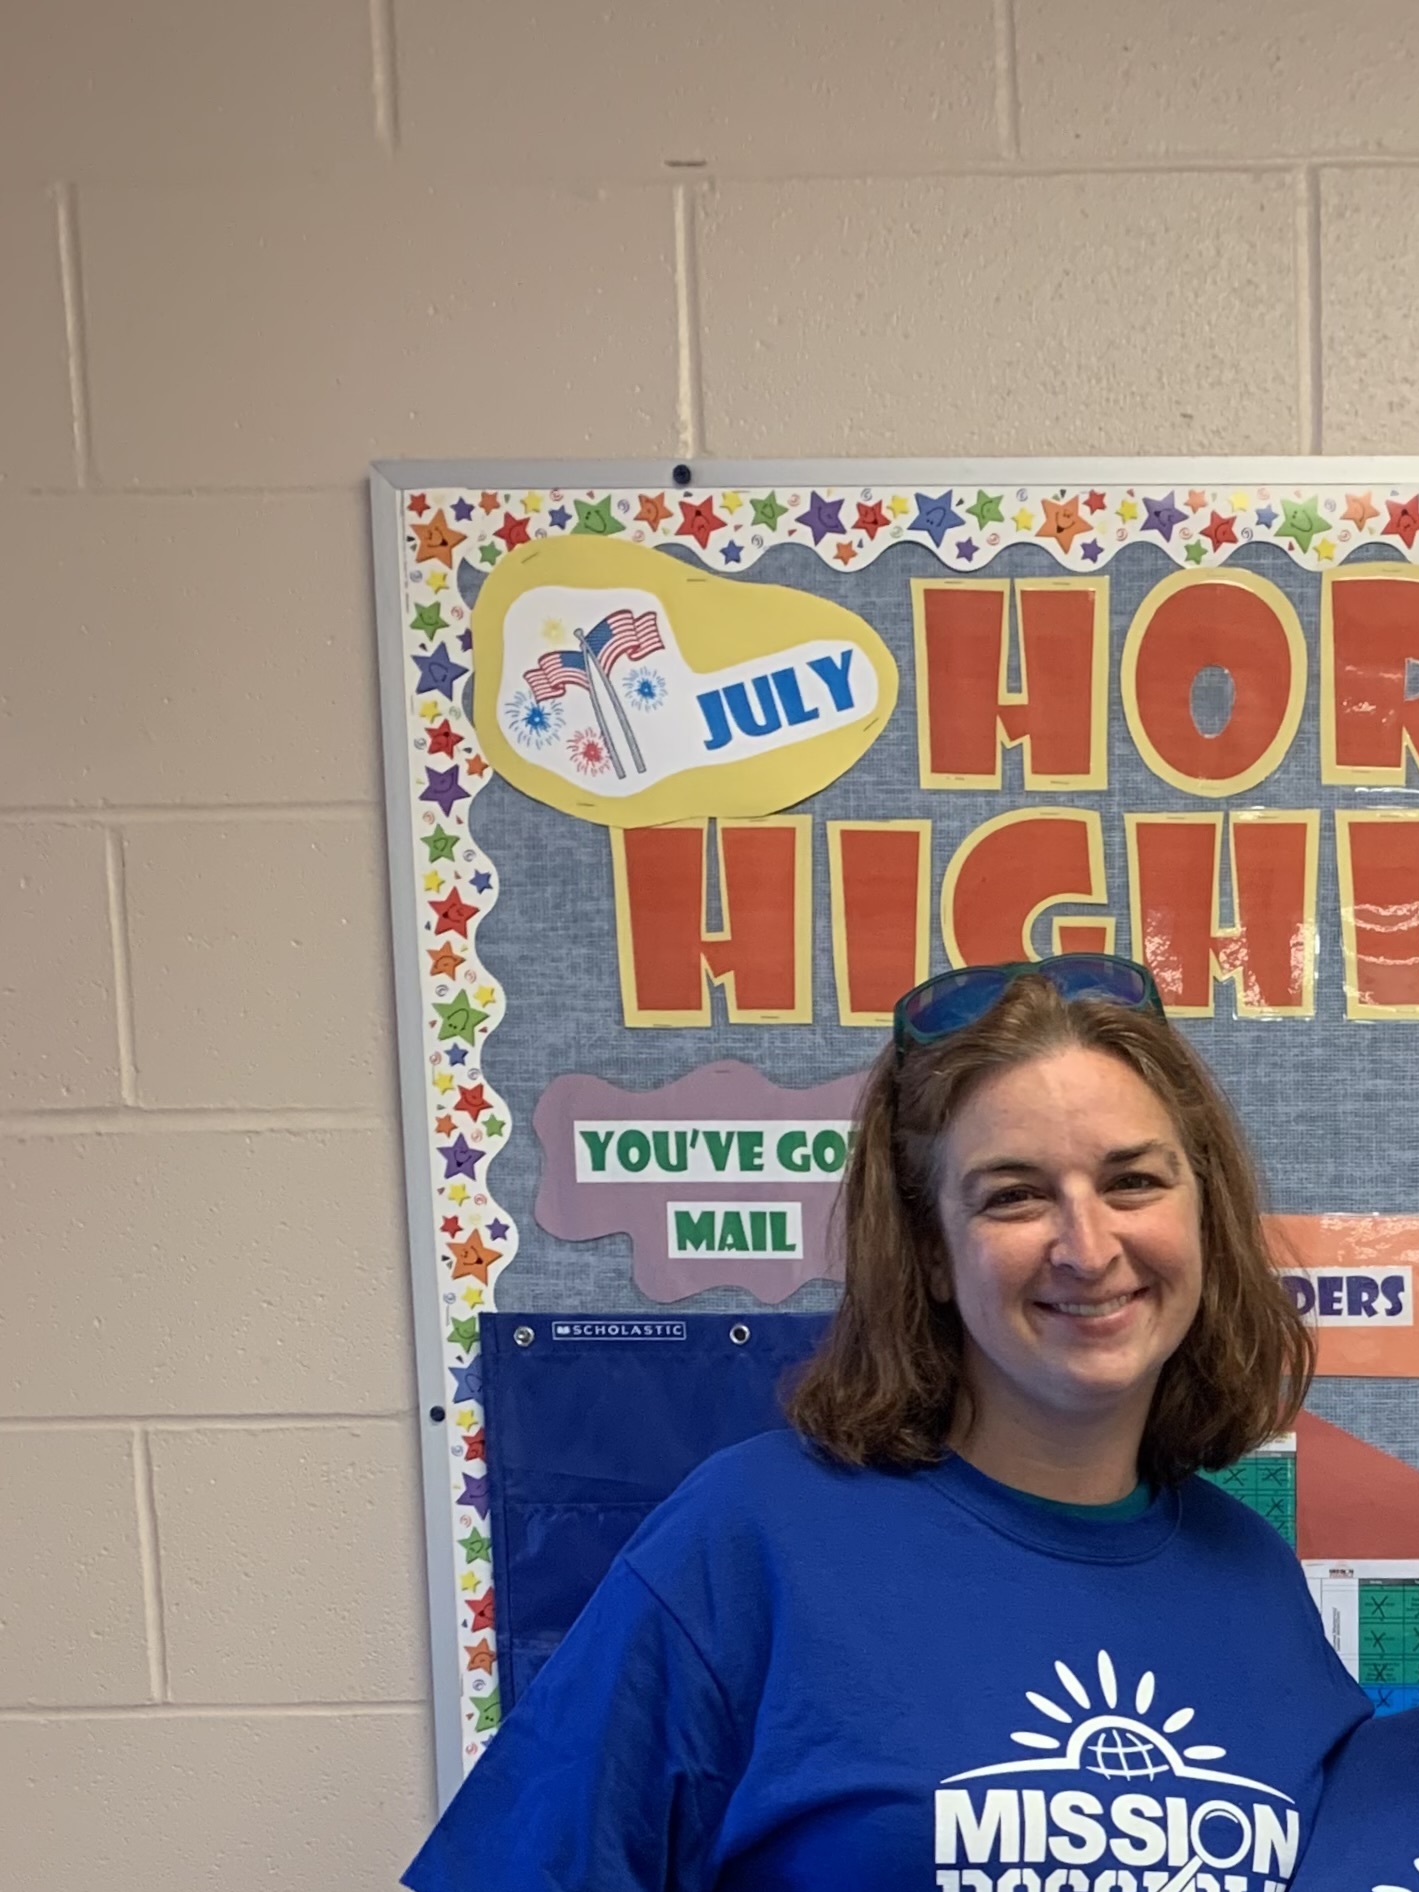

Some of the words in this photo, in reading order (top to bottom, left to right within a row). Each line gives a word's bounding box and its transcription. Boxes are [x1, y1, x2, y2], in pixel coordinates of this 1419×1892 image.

[696, 647, 858, 752] JULY
[578, 1128, 764, 1173] YOU'VE
[674, 1210, 797, 1252] MAIL
[1281, 1275, 1405, 1318] DERS
[572, 1325, 683, 1336] SCHOLASTIC
[935, 1789, 1299, 1880] MISSION
